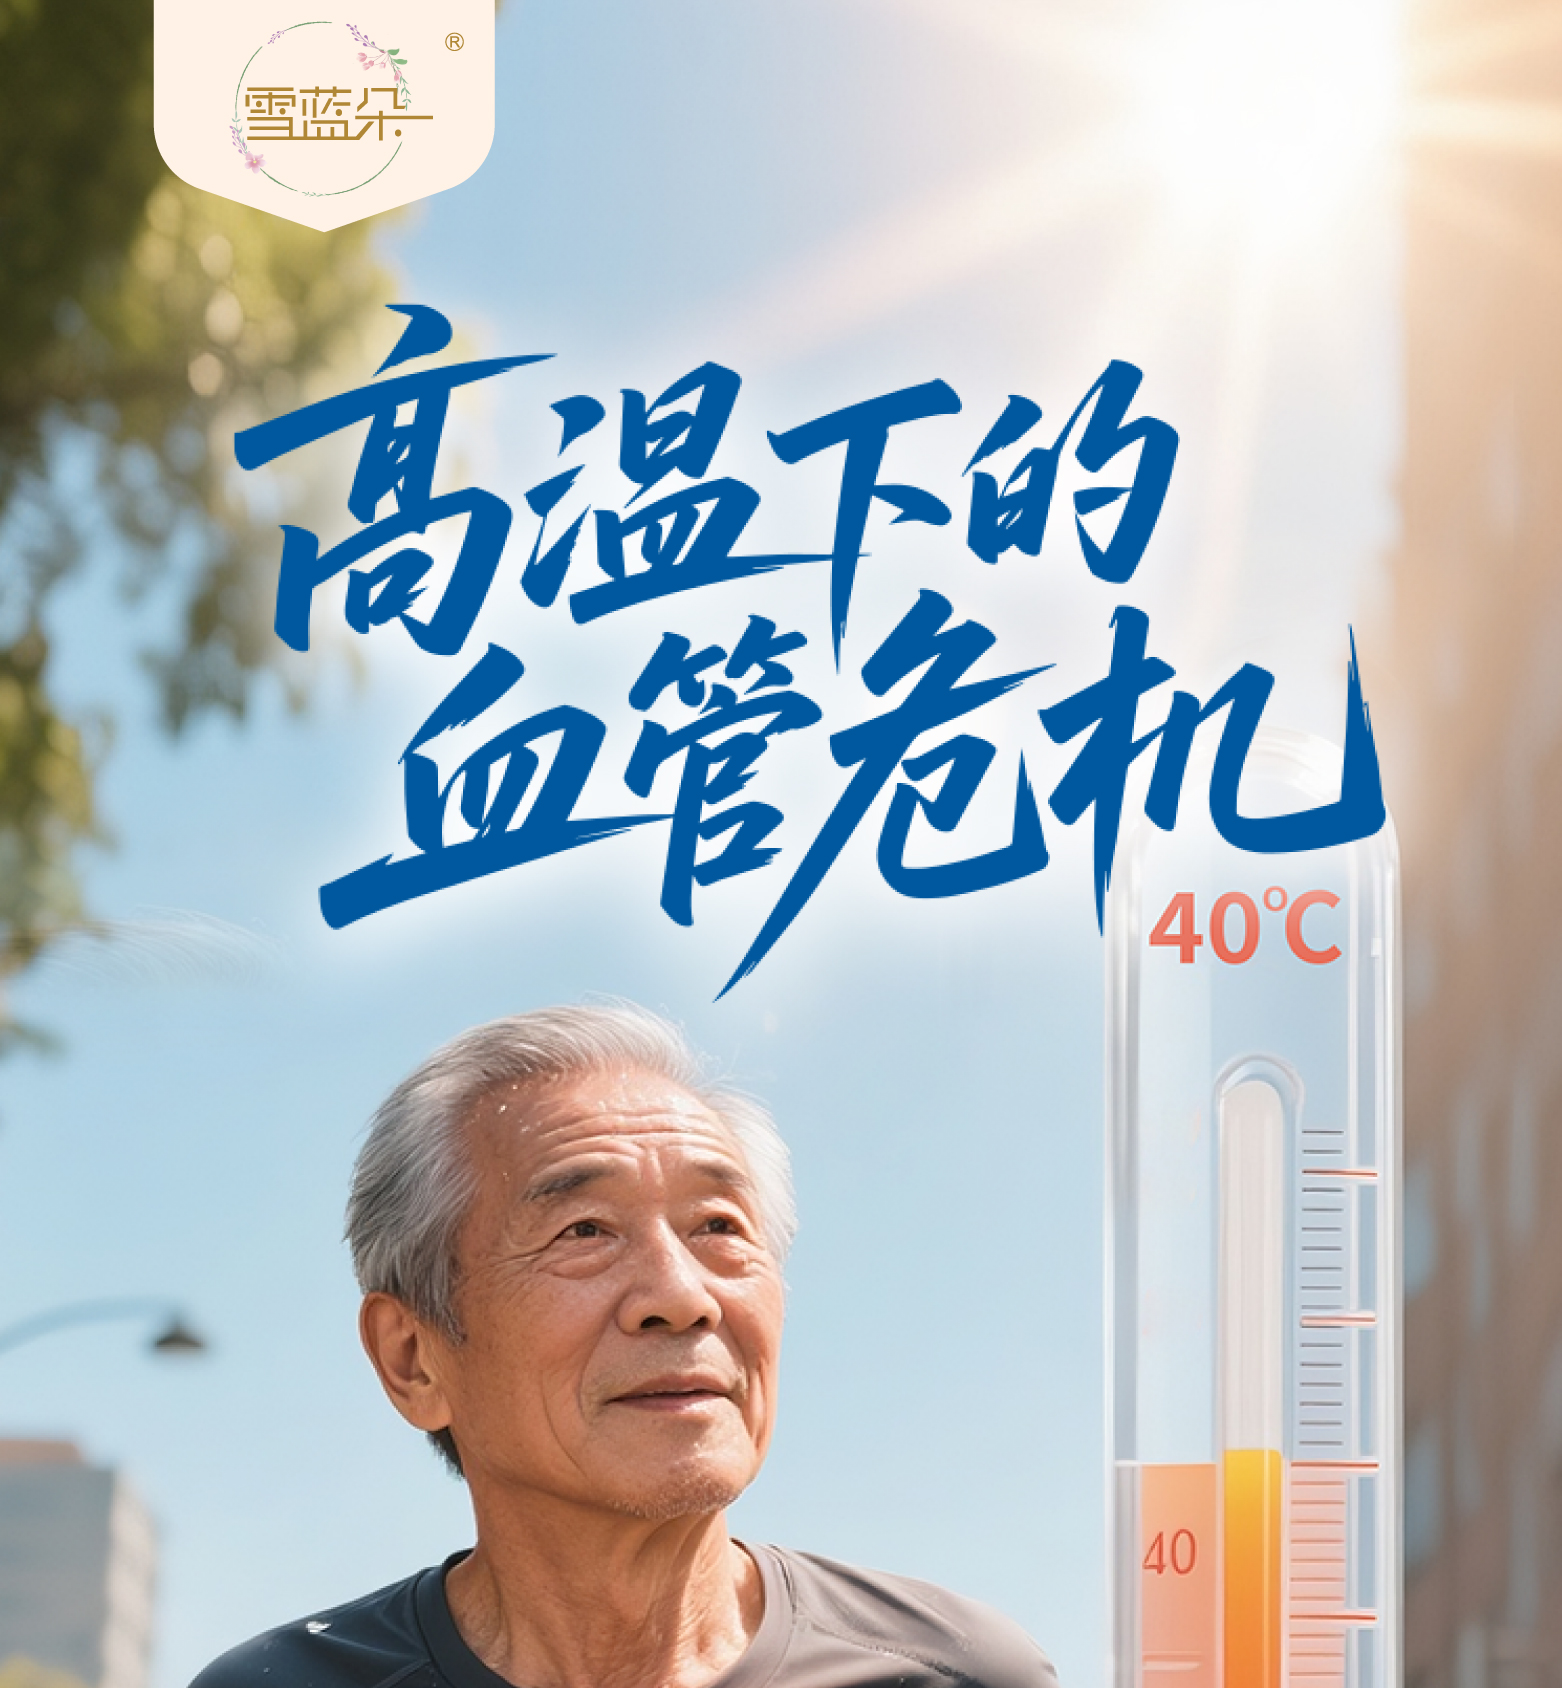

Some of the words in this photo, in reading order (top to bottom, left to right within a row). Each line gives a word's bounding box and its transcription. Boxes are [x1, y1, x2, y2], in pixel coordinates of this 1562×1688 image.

[245, 86, 434, 141] 雪蓝朵
[235, 303, 1180, 673] 高温下的
[318, 589, 1387, 1002] 血管危机
[1142, 1527, 1198, 1576] 40
